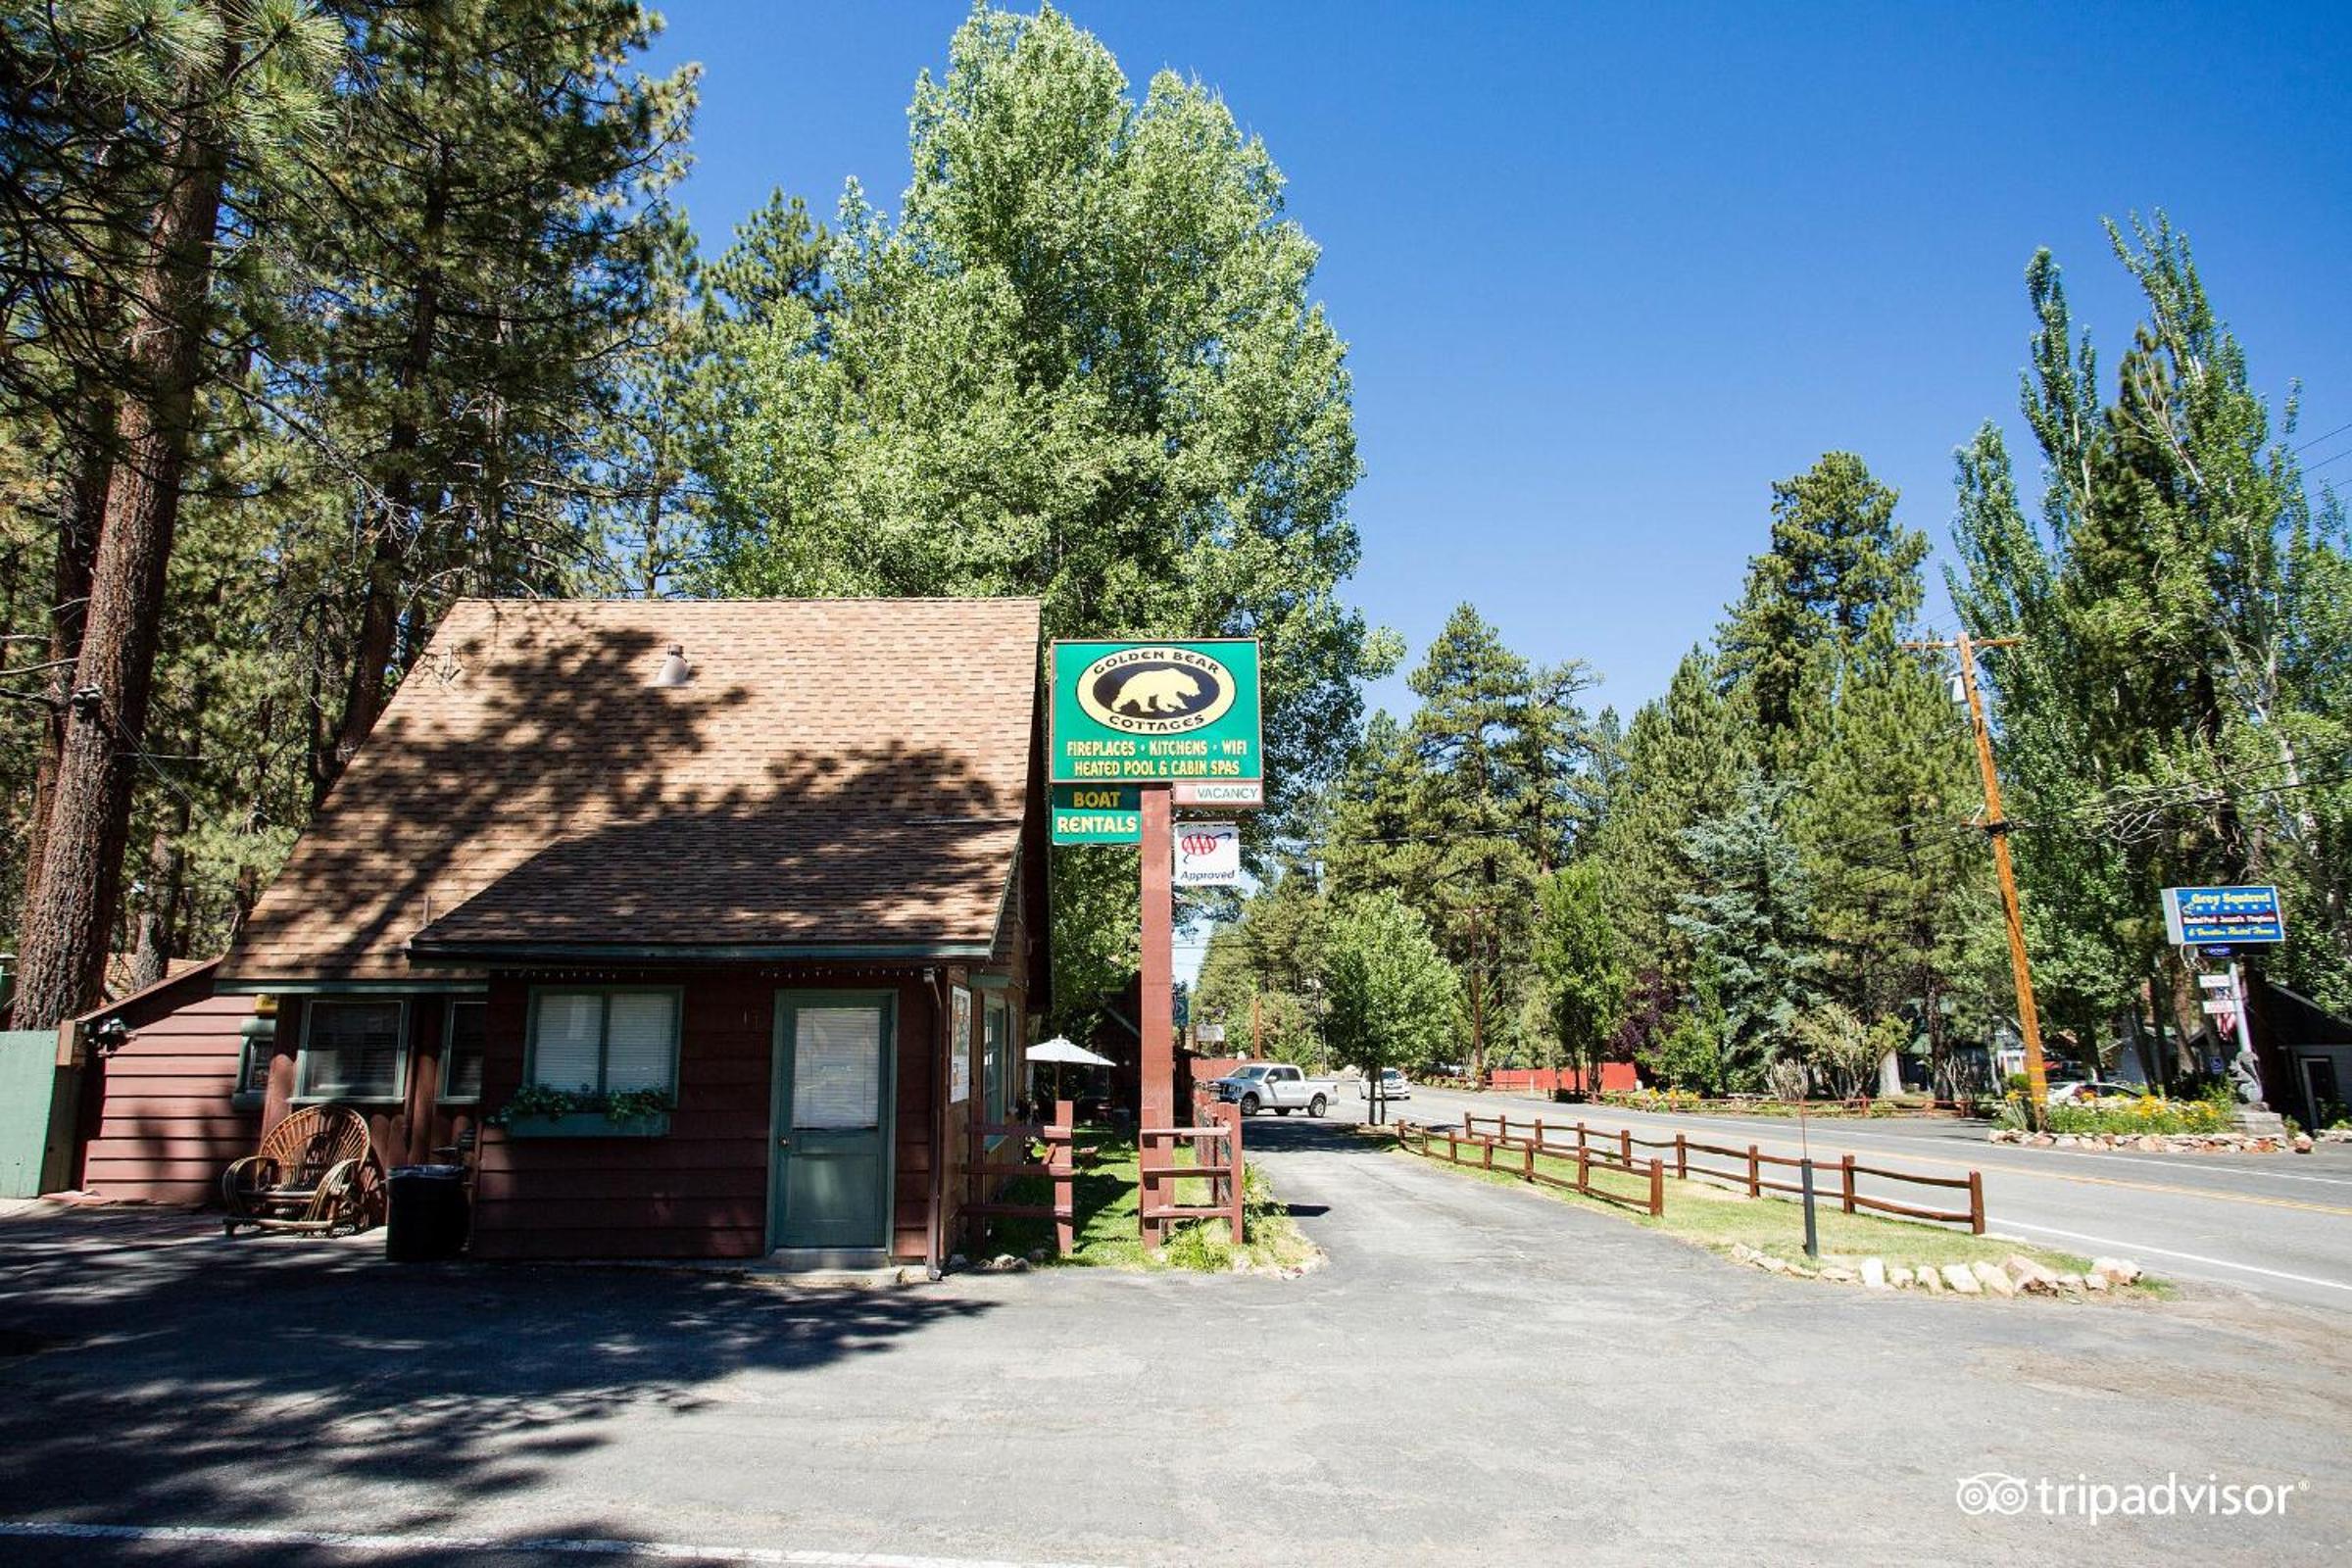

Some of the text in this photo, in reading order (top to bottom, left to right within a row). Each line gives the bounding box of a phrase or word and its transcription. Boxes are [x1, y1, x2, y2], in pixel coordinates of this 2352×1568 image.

[1093, 651, 1220, 675] GOLDEN BEAR
[1108, 713, 1205, 731] COTTAGES
[1066, 740, 1248, 757] FIREPLACES KITCHENS WIFI
[1074, 760, 1240, 776] HEATED POOL & CABIN SPAS
[1073, 792, 1121, 808] BOAT
[1197, 787, 1258, 799] VACANCY
[1057, 815, 1137, 833] RENTALS
[1182, 834, 1216, 855] AAA
[1180, 869, 1235, 881] Approved
